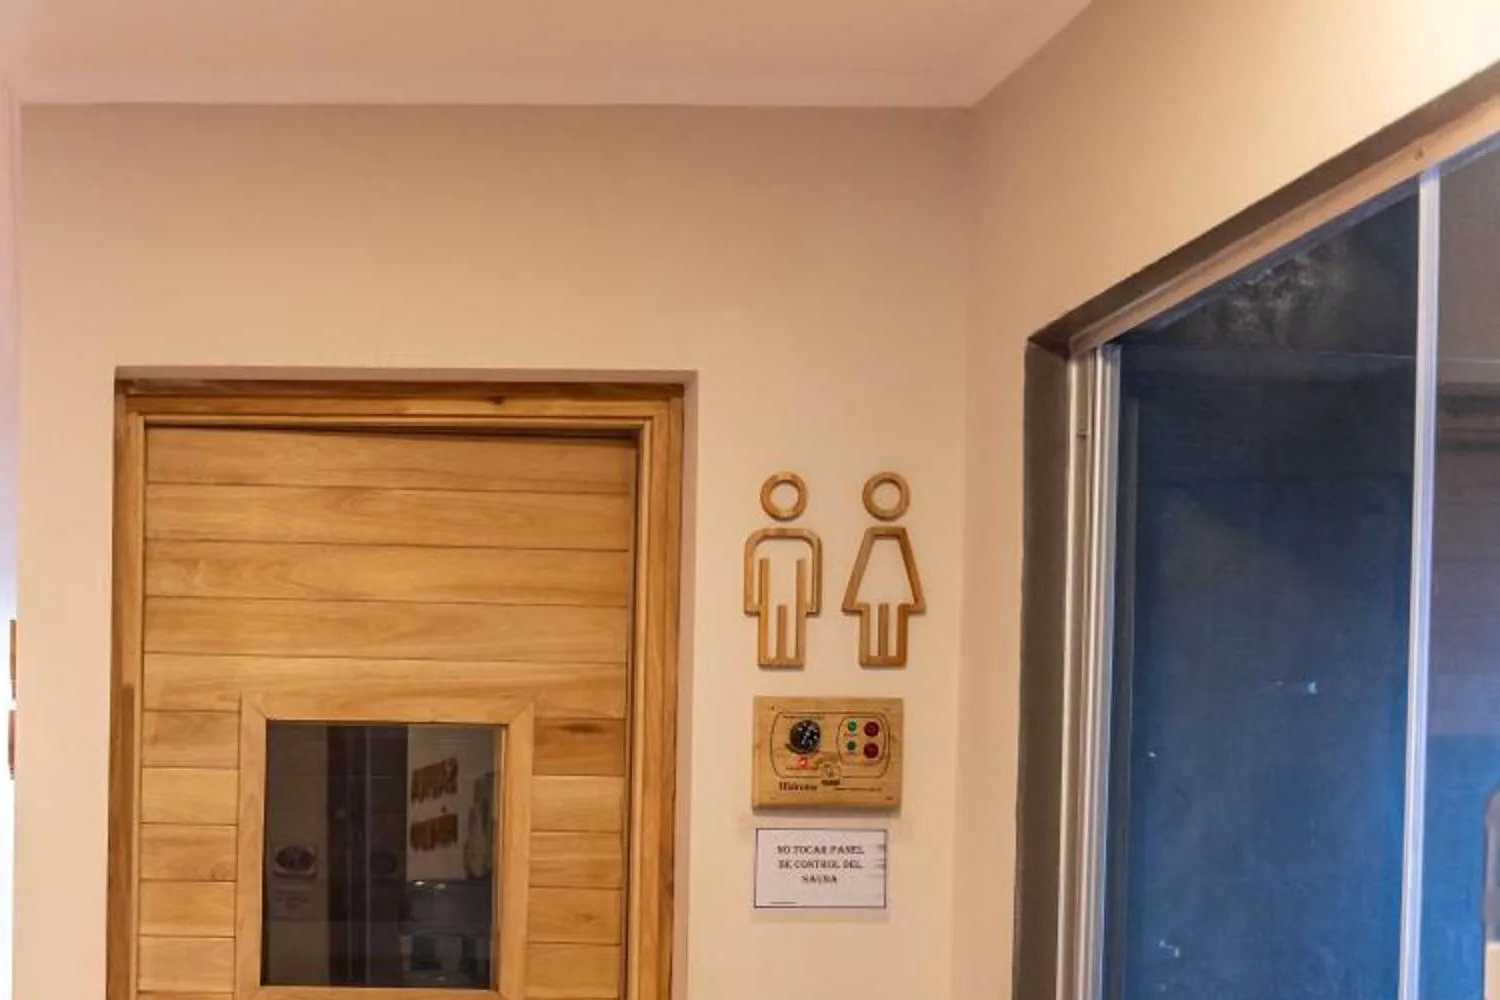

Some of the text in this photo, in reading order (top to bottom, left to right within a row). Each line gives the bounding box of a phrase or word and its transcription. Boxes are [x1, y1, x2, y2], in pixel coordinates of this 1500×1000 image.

[777, 845, 865, 854] NO TOCAR PANEL
[778, 860, 865, 869] DE CONTROL DEL
[801, 875, 837, 884] SAUNA
